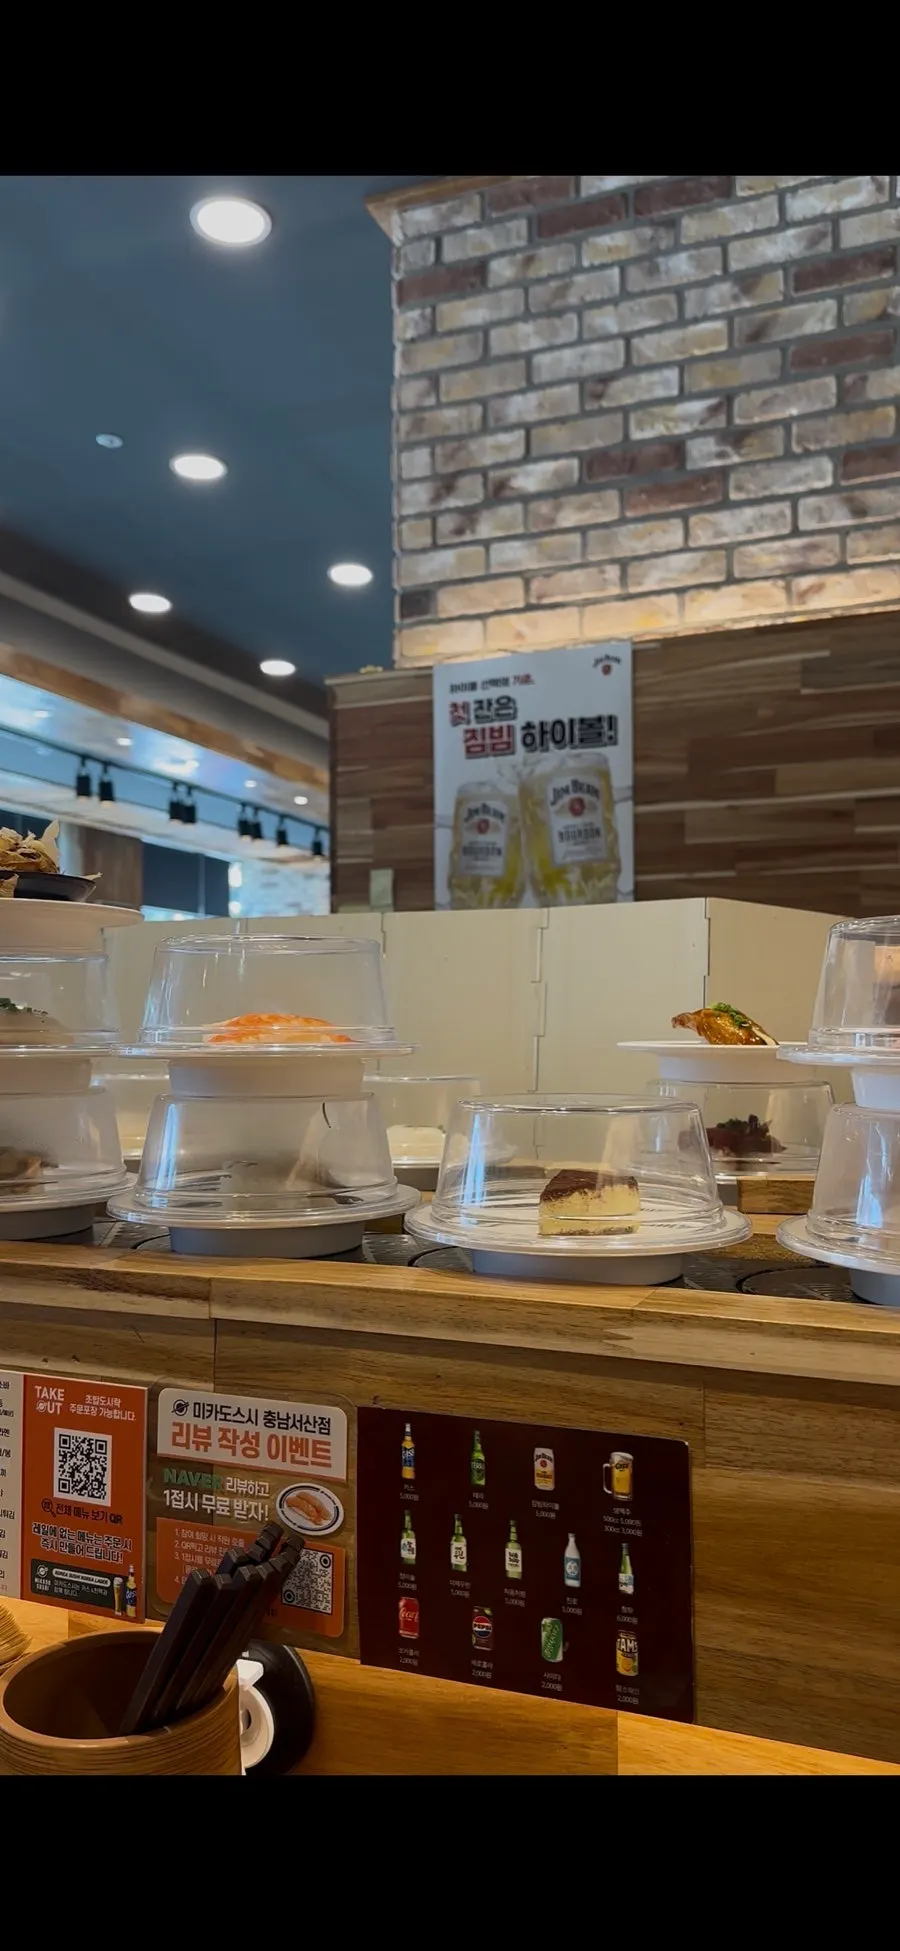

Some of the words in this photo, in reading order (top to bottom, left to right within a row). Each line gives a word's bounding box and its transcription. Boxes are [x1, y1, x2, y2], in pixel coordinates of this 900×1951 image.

[449, 700, 470, 727] 첫
[473, 695, 517, 723] 잔은
[463, 724, 516, 759] 짐빔
[521, 714, 618, 752] 하이볼!
[550, 784, 570, 806] JIM
[34, 1385, 65, 1401] TAKE
[85, 1394, 121, 1408] 초밥도시락
[69, 1403, 97, 1417] 주문포장
[98, 1407, 137, 1421] 가능합니다.
[193, 1402, 258, 1426] 미카도스시
[263, 1410, 331, 1436] 충남서산점
[171, 1421, 212, 1452] 리뷰
[218, 1427, 260, 1459] 작성
[267, 1433, 332, 1468] 이벤트
[163, 1468, 223, 1489] NAVER
[226, 1477, 270, 1496] 리뷰하고
[56, 1503, 72, 1516] 전체
[73, 1506, 89, 1520] 메뉴
[91, 1510, 108, 1523] 보기
[109, 1512, 123, 1524] QR
[163, 1489, 198, 1512] 1접시
[202, 1494, 230, 1516] 무료
[233, 1499, 269, 1521] 받자!
[32, 1522, 58, 1537] 레일에
[59, 1526, 76, 1541] 없는
[77, 1530, 102, 1546] 메뉴는
[104, 1534, 121, 1549] 주문
[123, 1538, 133, 1552] 시
[41, 1537, 58, 1552] 즉시
[59, 1539, 85, 1557] 만들어
[85, 1545, 124, 1564] 드립니다!
